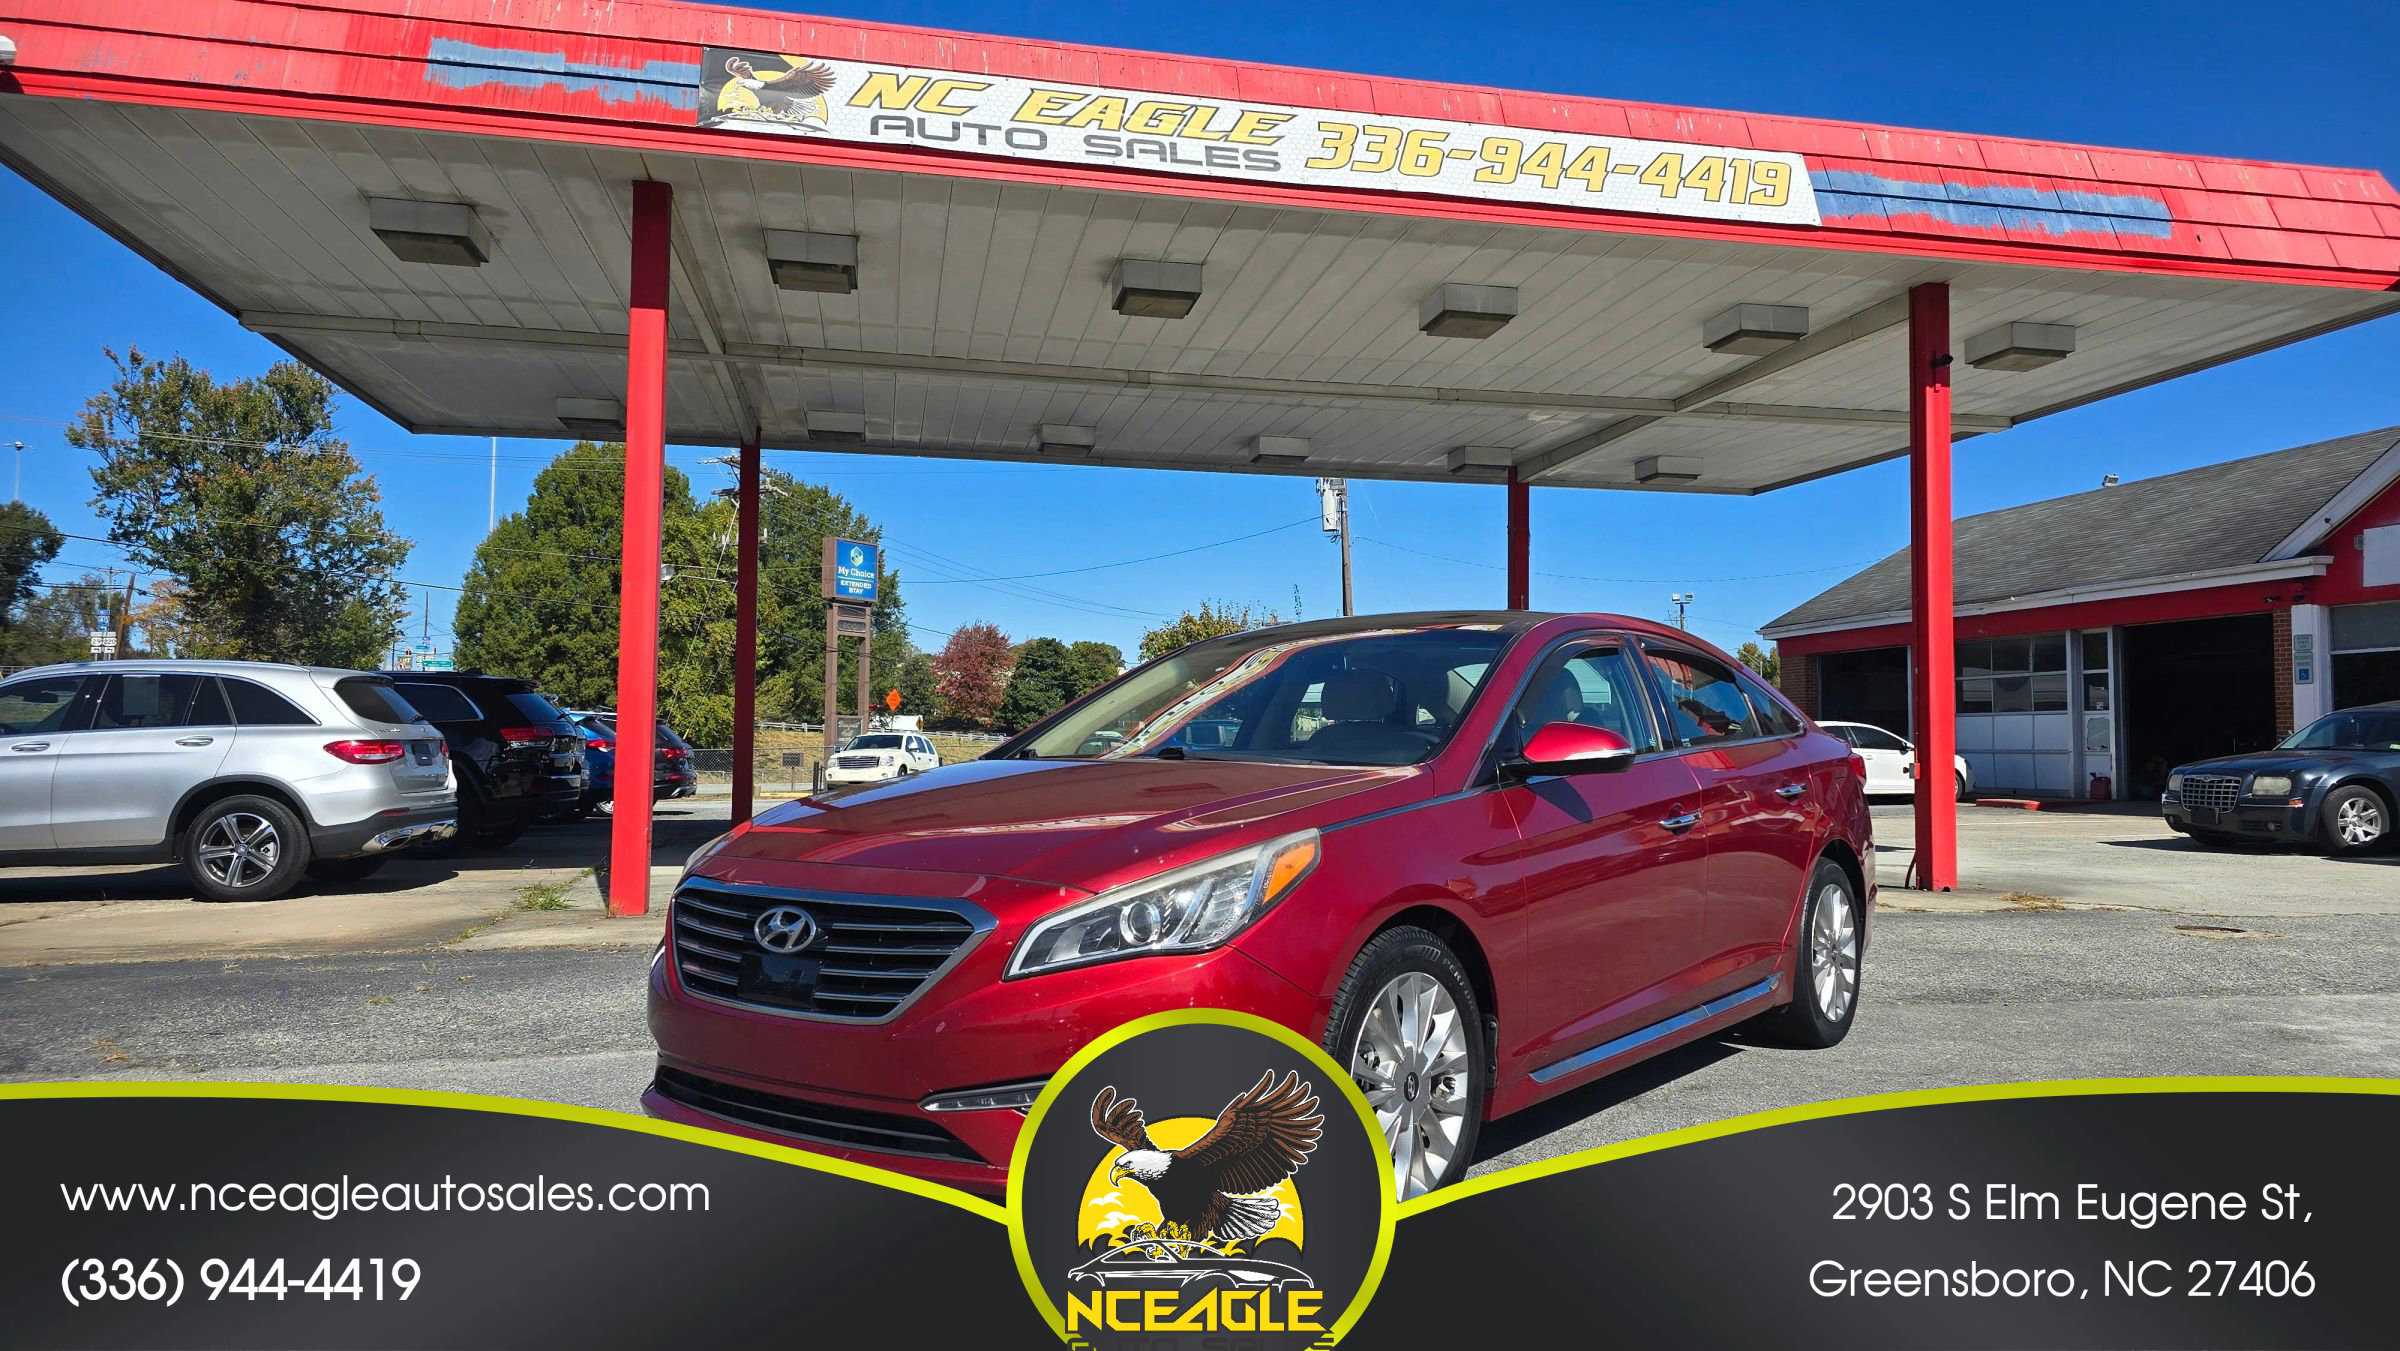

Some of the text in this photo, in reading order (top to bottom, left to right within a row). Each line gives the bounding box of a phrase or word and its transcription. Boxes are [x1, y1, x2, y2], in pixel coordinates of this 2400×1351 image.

[845, 71, 1299, 146] NC EAGLE
[870, 115, 1282, 172] AUTO SALES
[1304, 121, 1792, 207] 336-944-4419
[838, 566, 875, 579] My Choice
[840, 580, 872, 589] EXTENDED
